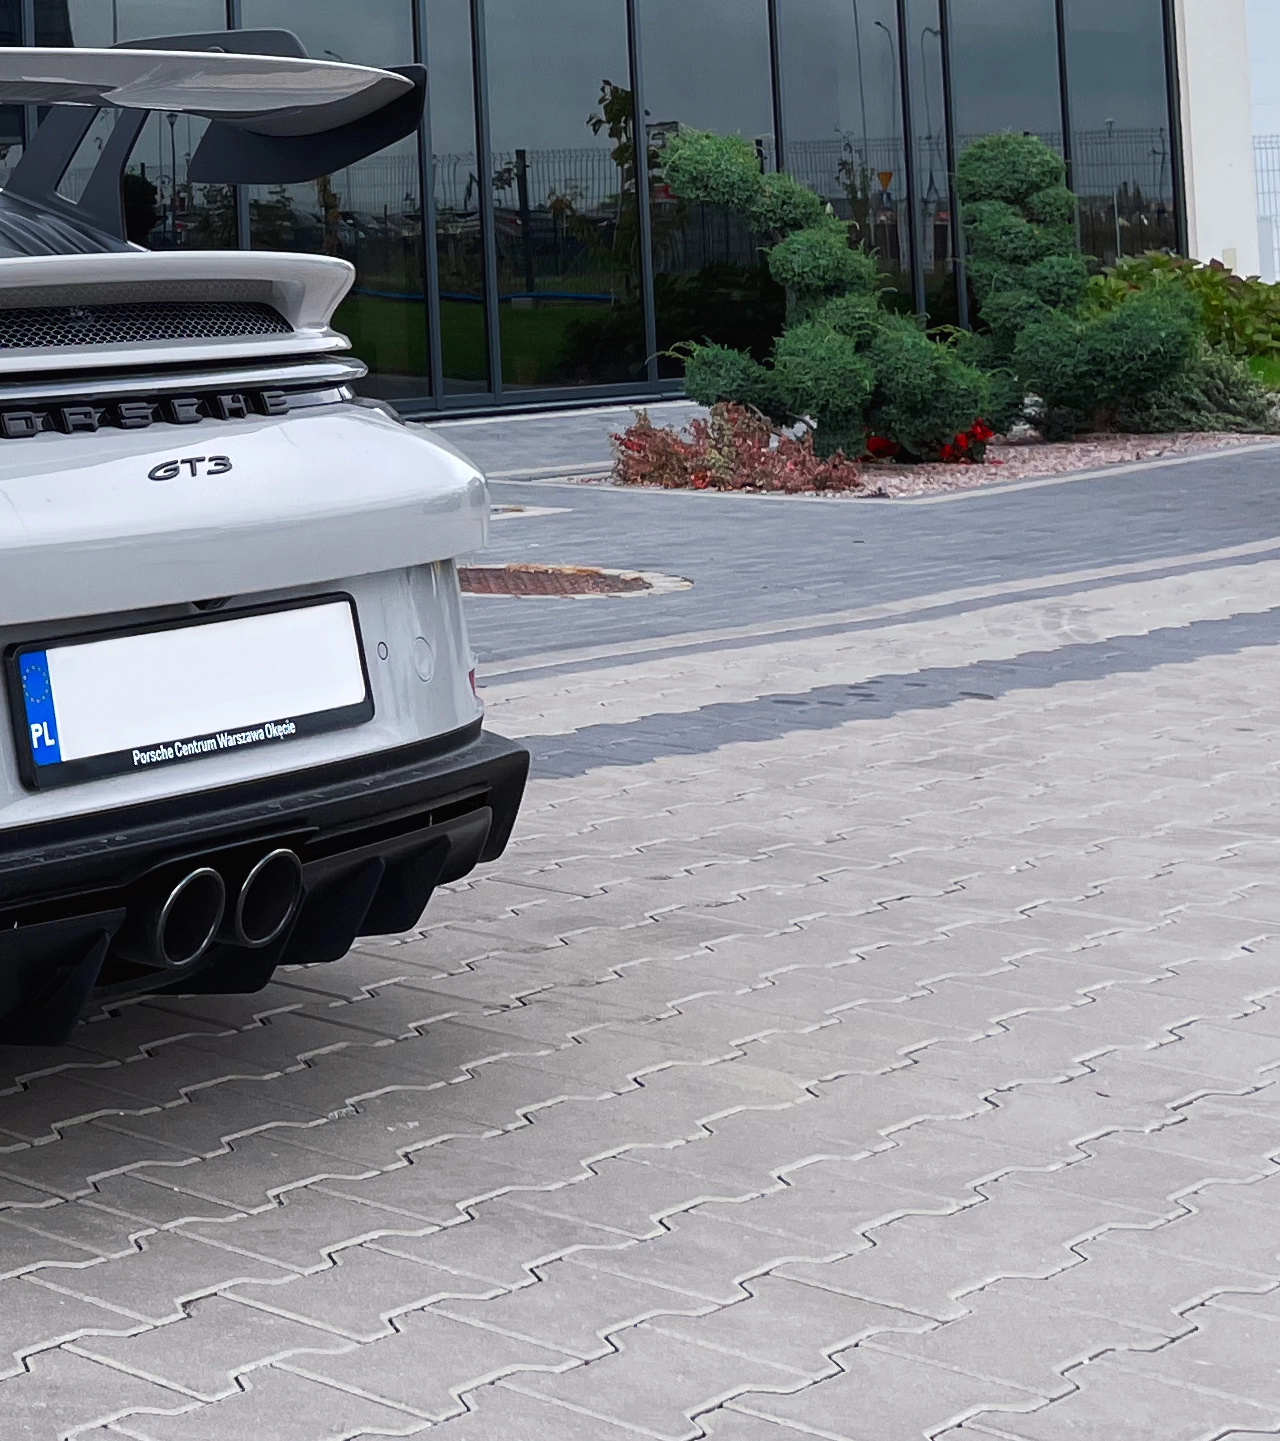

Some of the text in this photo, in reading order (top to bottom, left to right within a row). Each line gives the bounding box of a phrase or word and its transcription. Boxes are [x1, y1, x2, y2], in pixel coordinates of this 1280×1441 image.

[147, 455, 233, 482] GT3
[30, 721, 56, 749] PL
[132, 719, 296, 766] Porsche Centrum Warszawa Okęcie
